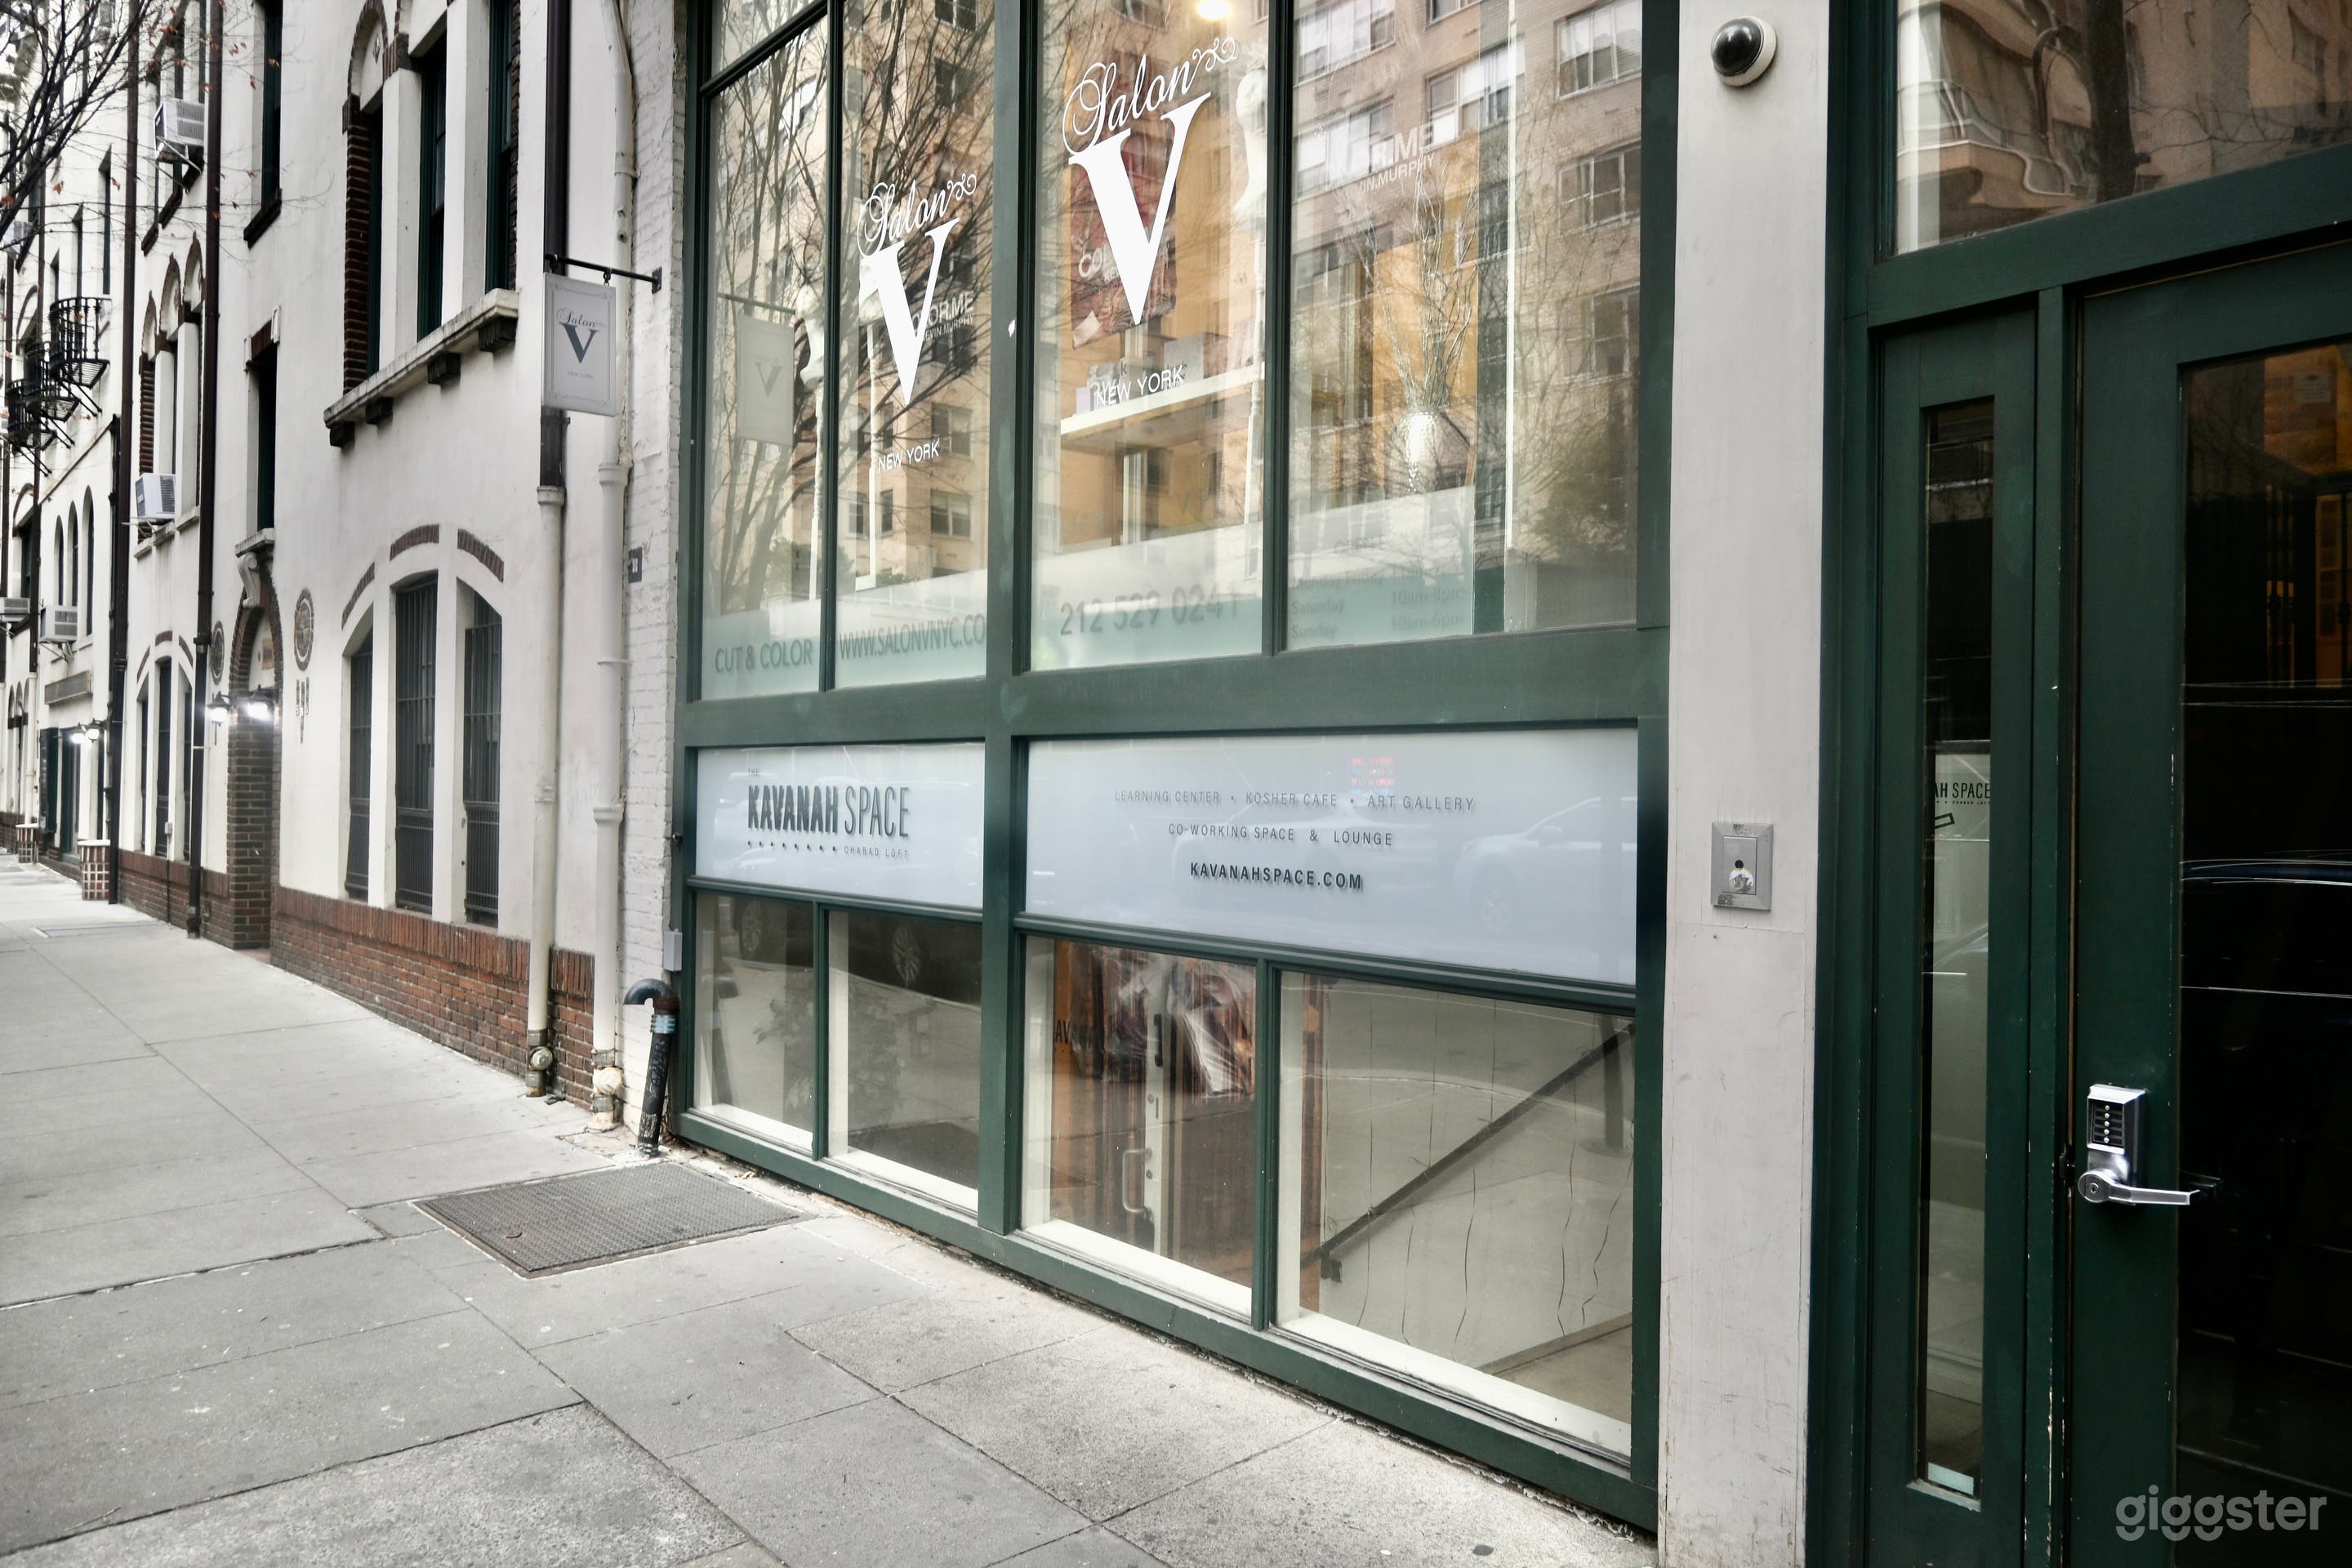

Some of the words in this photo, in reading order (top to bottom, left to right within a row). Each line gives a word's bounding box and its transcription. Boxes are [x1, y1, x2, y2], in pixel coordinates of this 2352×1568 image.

[1062, 39, 1234, 156] Salon
[858, 173, 976, 257] Salon
[1068, 91, 1212, 326] V
[862, 217, 960, 407] V
[559, 322, 600, 364] V
[1094, 380, 1132, 410] NEW
[1138, 364, 1184, 395] YORK
[878, 450, 903, 471] NEW
[906, 439, 940, 465] YORK
[1059, 599, 1104, 635] 212
[1114, 589, 1160, 630] 529
[1292, 598, 1346, 618] Saturday
[715, 647, 744, 674] CUT
[745, 644, 755, 670] &
[760, 638, 813, 669] COLOR
[1115, 790, 1169, 803] LEARNING
[1174, 791, 1221, 804] CENTER
[1245, 792, 1298, 805] KOSHER
[1303, 794, 1337, 807] CAFE
[1367, 795, 1395, 808] ART
[1402, 795, 1475, 811] GALLERY
[1952, 782, 1990, 799] SPACE
[748, 785, 839, 834] KAVANAH
[844, 786, 911, 837] SPACE
[844, 845, 880, 857] CHABAD
[885, 849, 909, 859] LOFT
[1169, 822, 1249, 839] CO-WORKING
[1254, 826, 1295, 841] SPACE
[1309, 830, 1319, 843] &
[1333, 830, 1392, 846] LOUNGE
[1190, 862, 1362, 890] KAVANAHSPACE.COM
